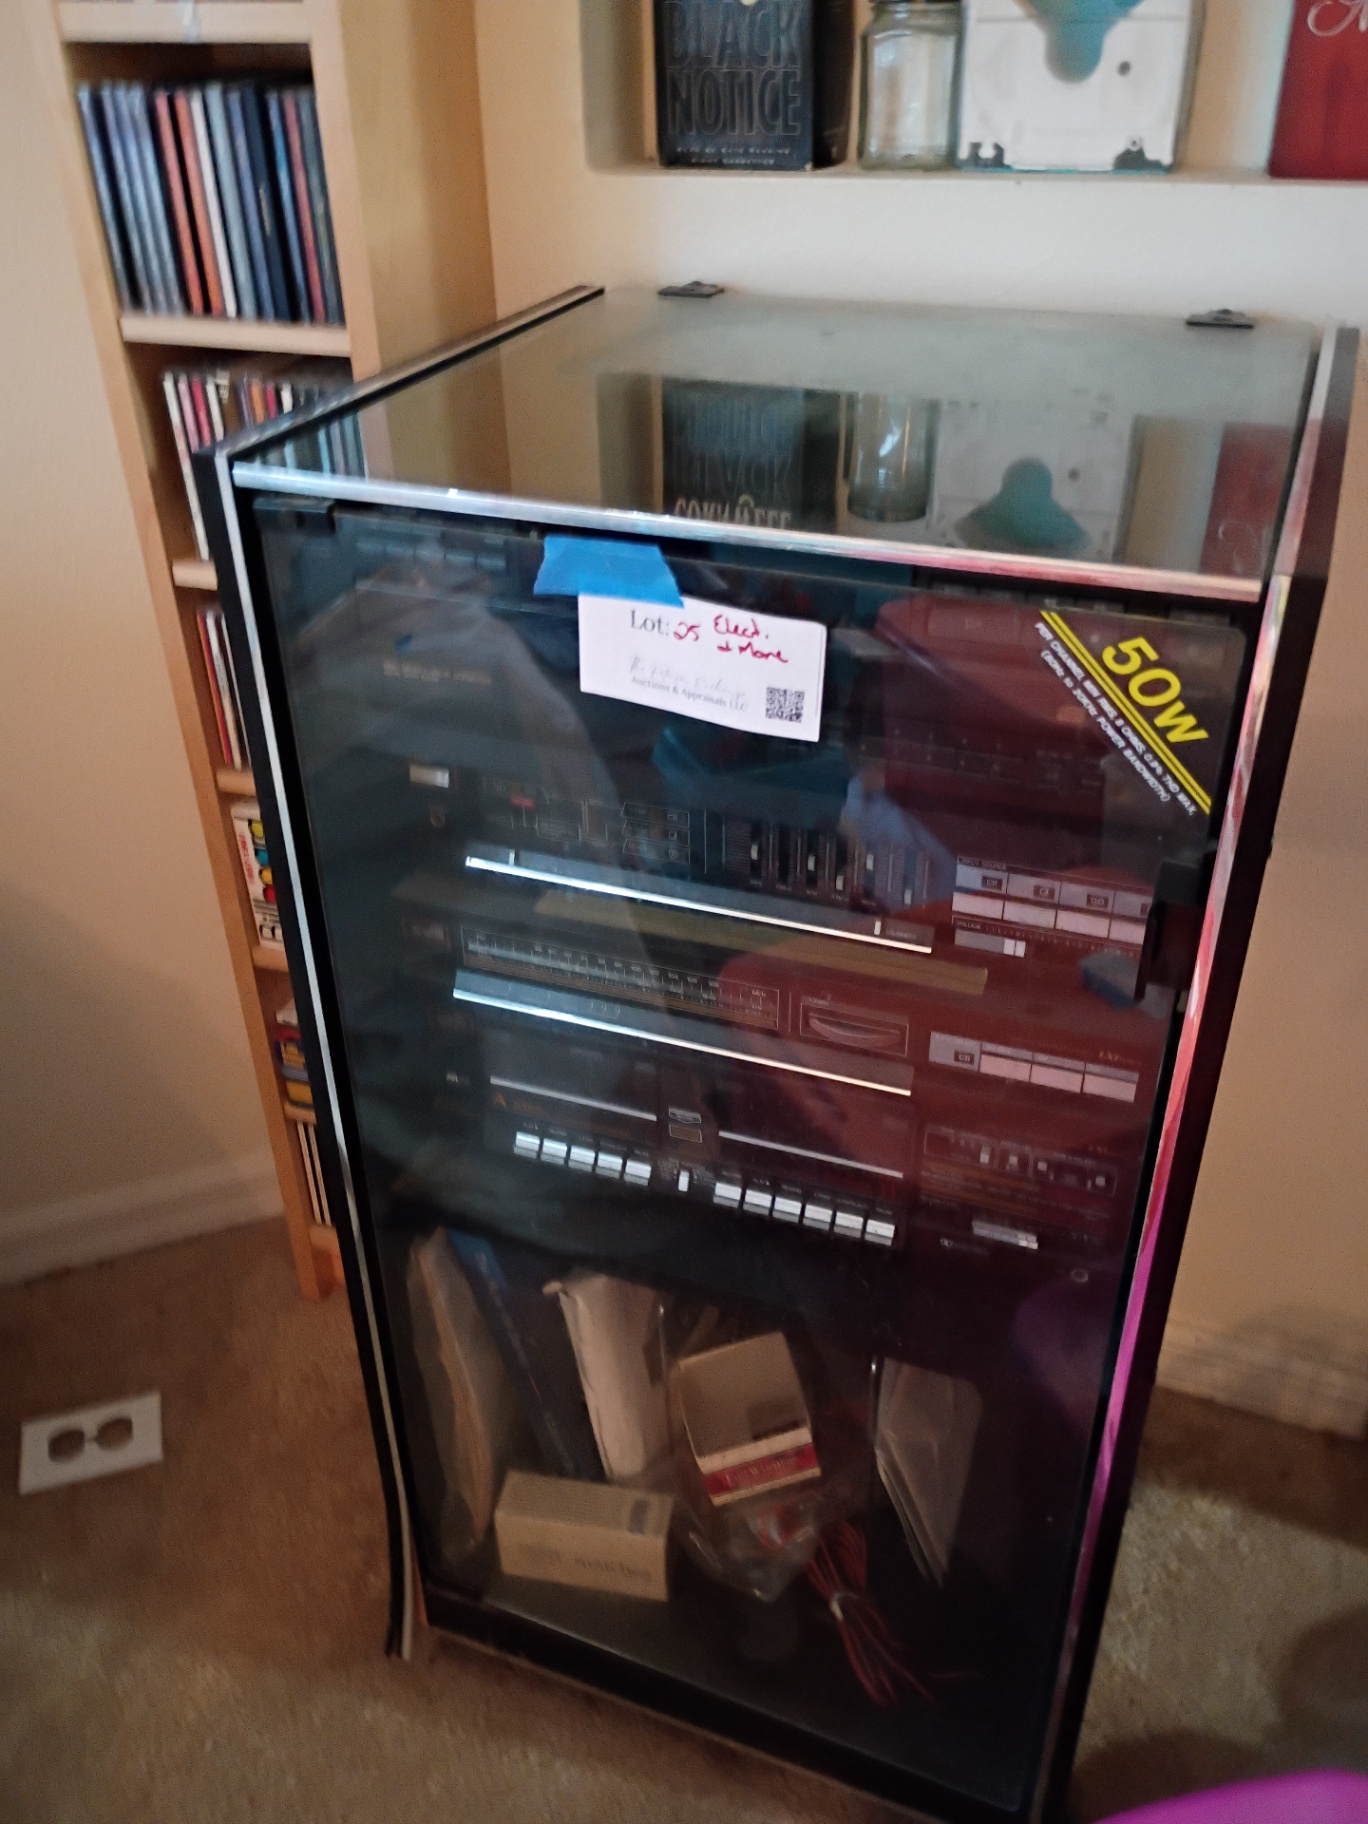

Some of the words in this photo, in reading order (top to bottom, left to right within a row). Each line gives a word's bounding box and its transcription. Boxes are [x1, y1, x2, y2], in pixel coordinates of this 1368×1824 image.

[664, 2, 801, 68] BLACK
[666, 69, 801, 136] NOTICE
[630, 609, 669, 636] Lot:
[1034, 622, 1054, 641] PER
[1050, 640, 1084, 681] CHANNEL
[631, 676, 671, 692] Auctions
[682, 688, 727, 708] Appraisals
[1102, 636, 1209, 743] 50W
[1096, 716, 1126, 749] POWER
